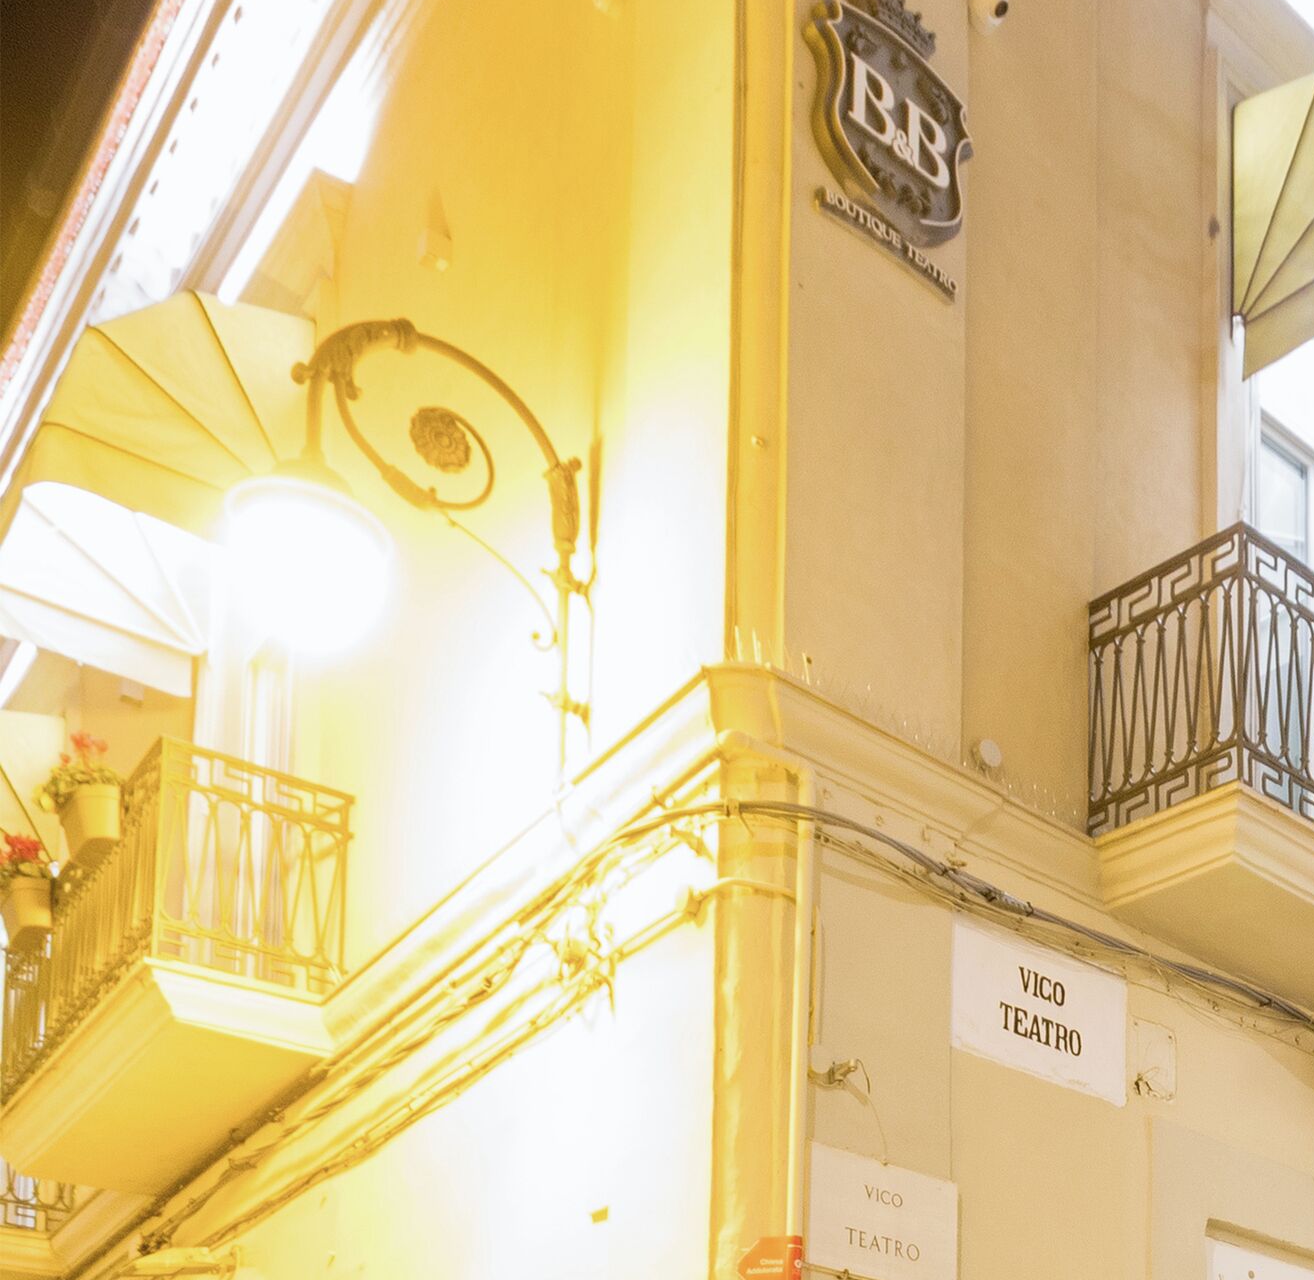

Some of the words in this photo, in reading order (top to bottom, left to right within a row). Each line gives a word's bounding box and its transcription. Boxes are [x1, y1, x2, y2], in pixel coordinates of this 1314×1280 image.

[848, 53, 951, 189] B&B
[826, 190, 902, 249] BOUTIQUE
[905, 241, 957, 292] TEATRO
[1018, 966, 1065, 1007] VICO
[1000, 1001, 1082, 1057] TEATRO
[864, 1184, 904, 1209] VICO
[846, 1226, 921, 1262] TEATRO
